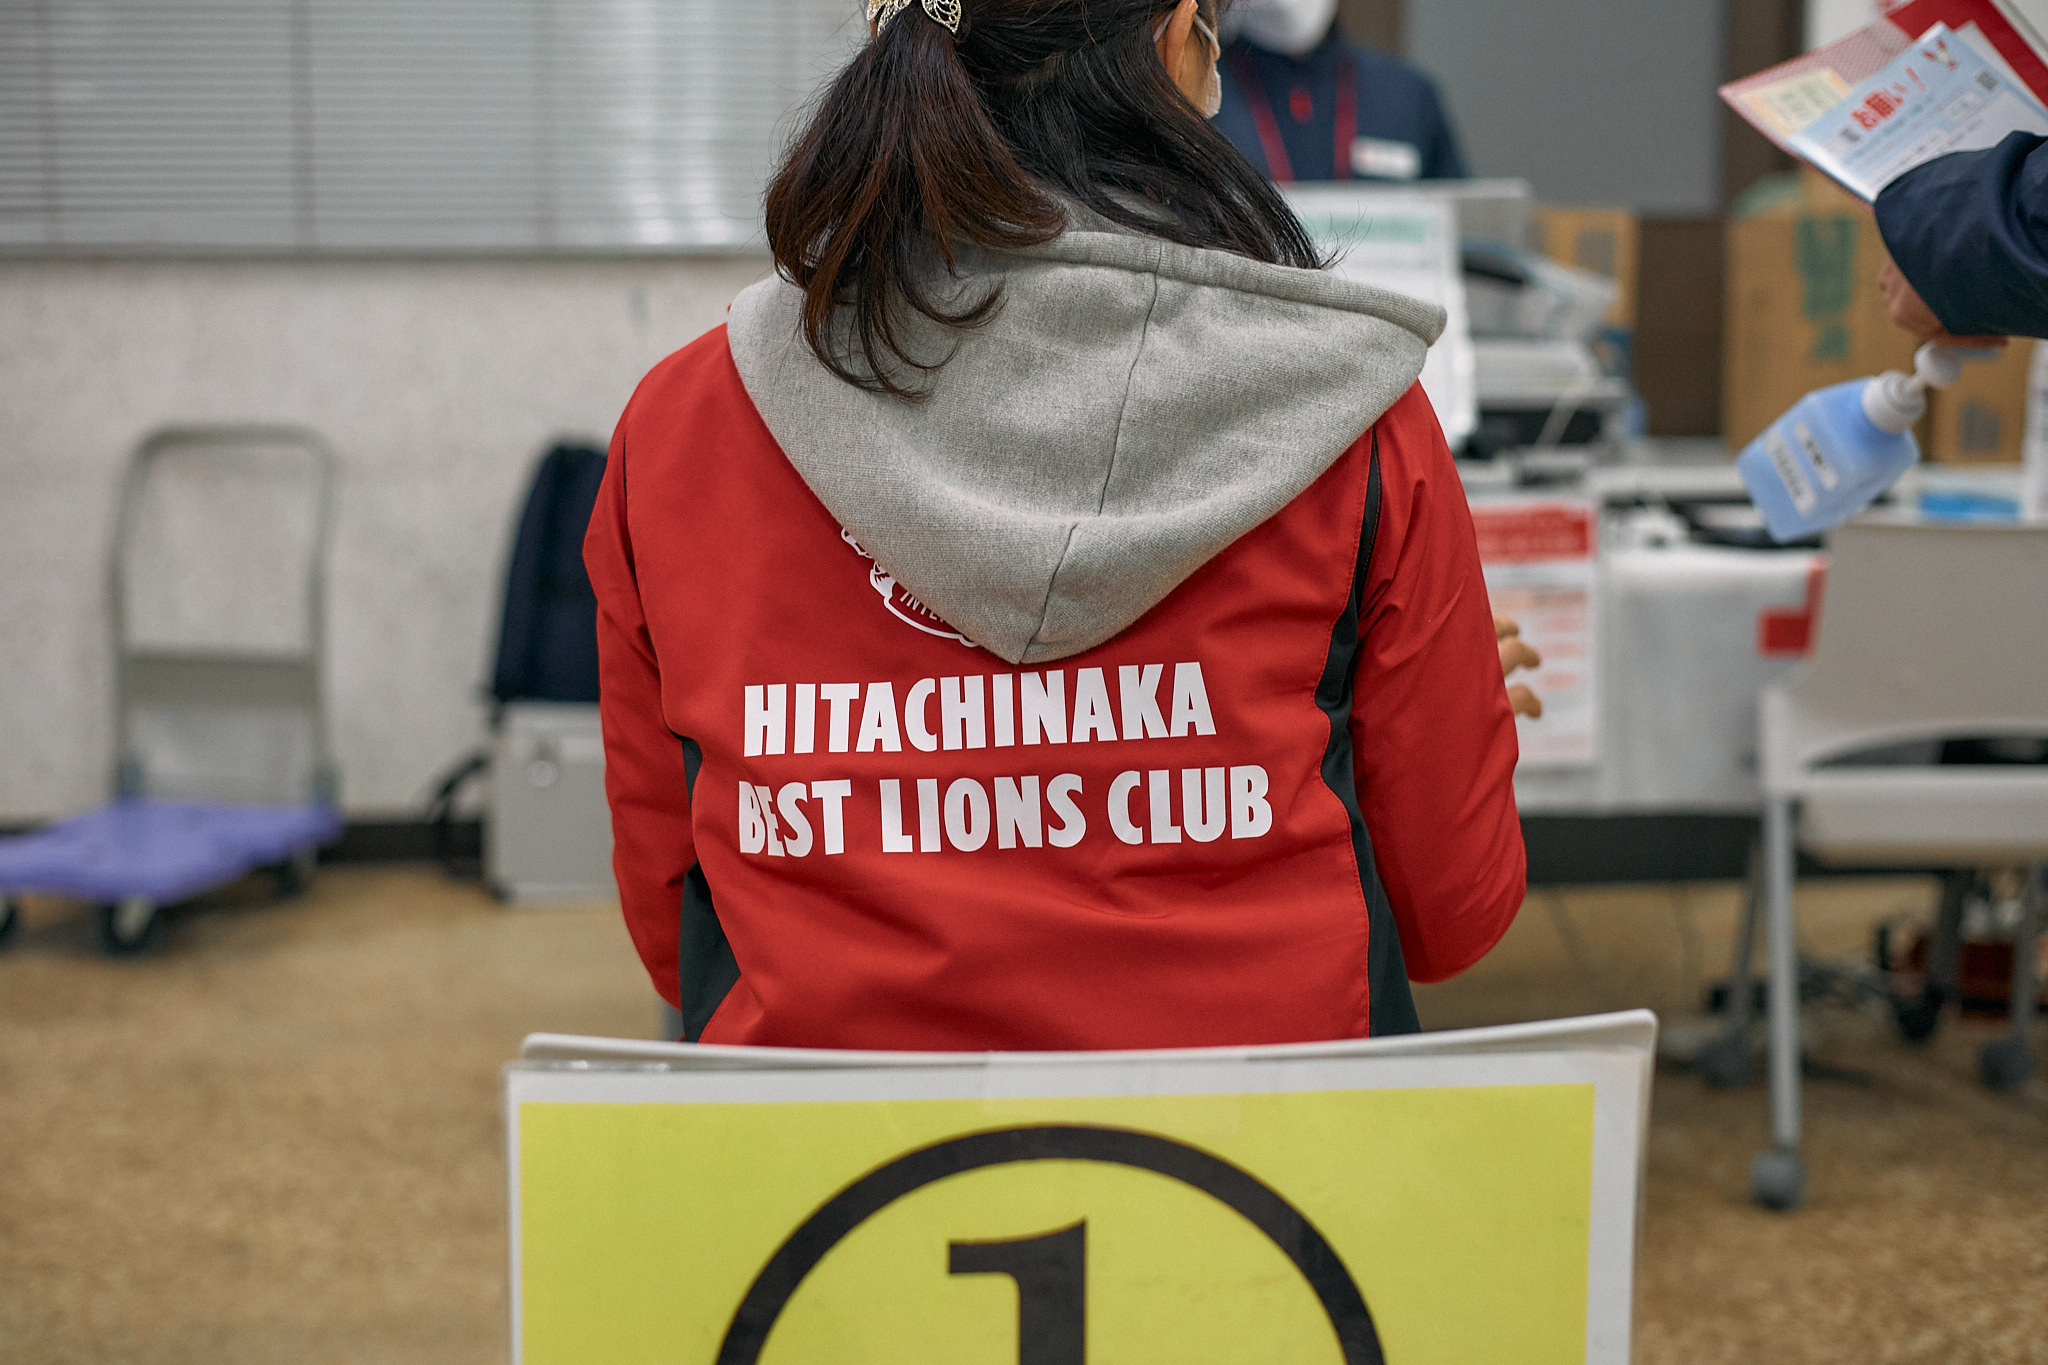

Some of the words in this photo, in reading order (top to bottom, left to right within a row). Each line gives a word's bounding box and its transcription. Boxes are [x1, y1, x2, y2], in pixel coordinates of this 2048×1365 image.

[900, 591, 944, 622] INTE
[743, 661, 1217, 758] HITACHINAKA
[738, 779, 852, 858] BEST
[879, 773, 1087, 853] LIONS
[1107, 764, 1274, 845] CLUB
